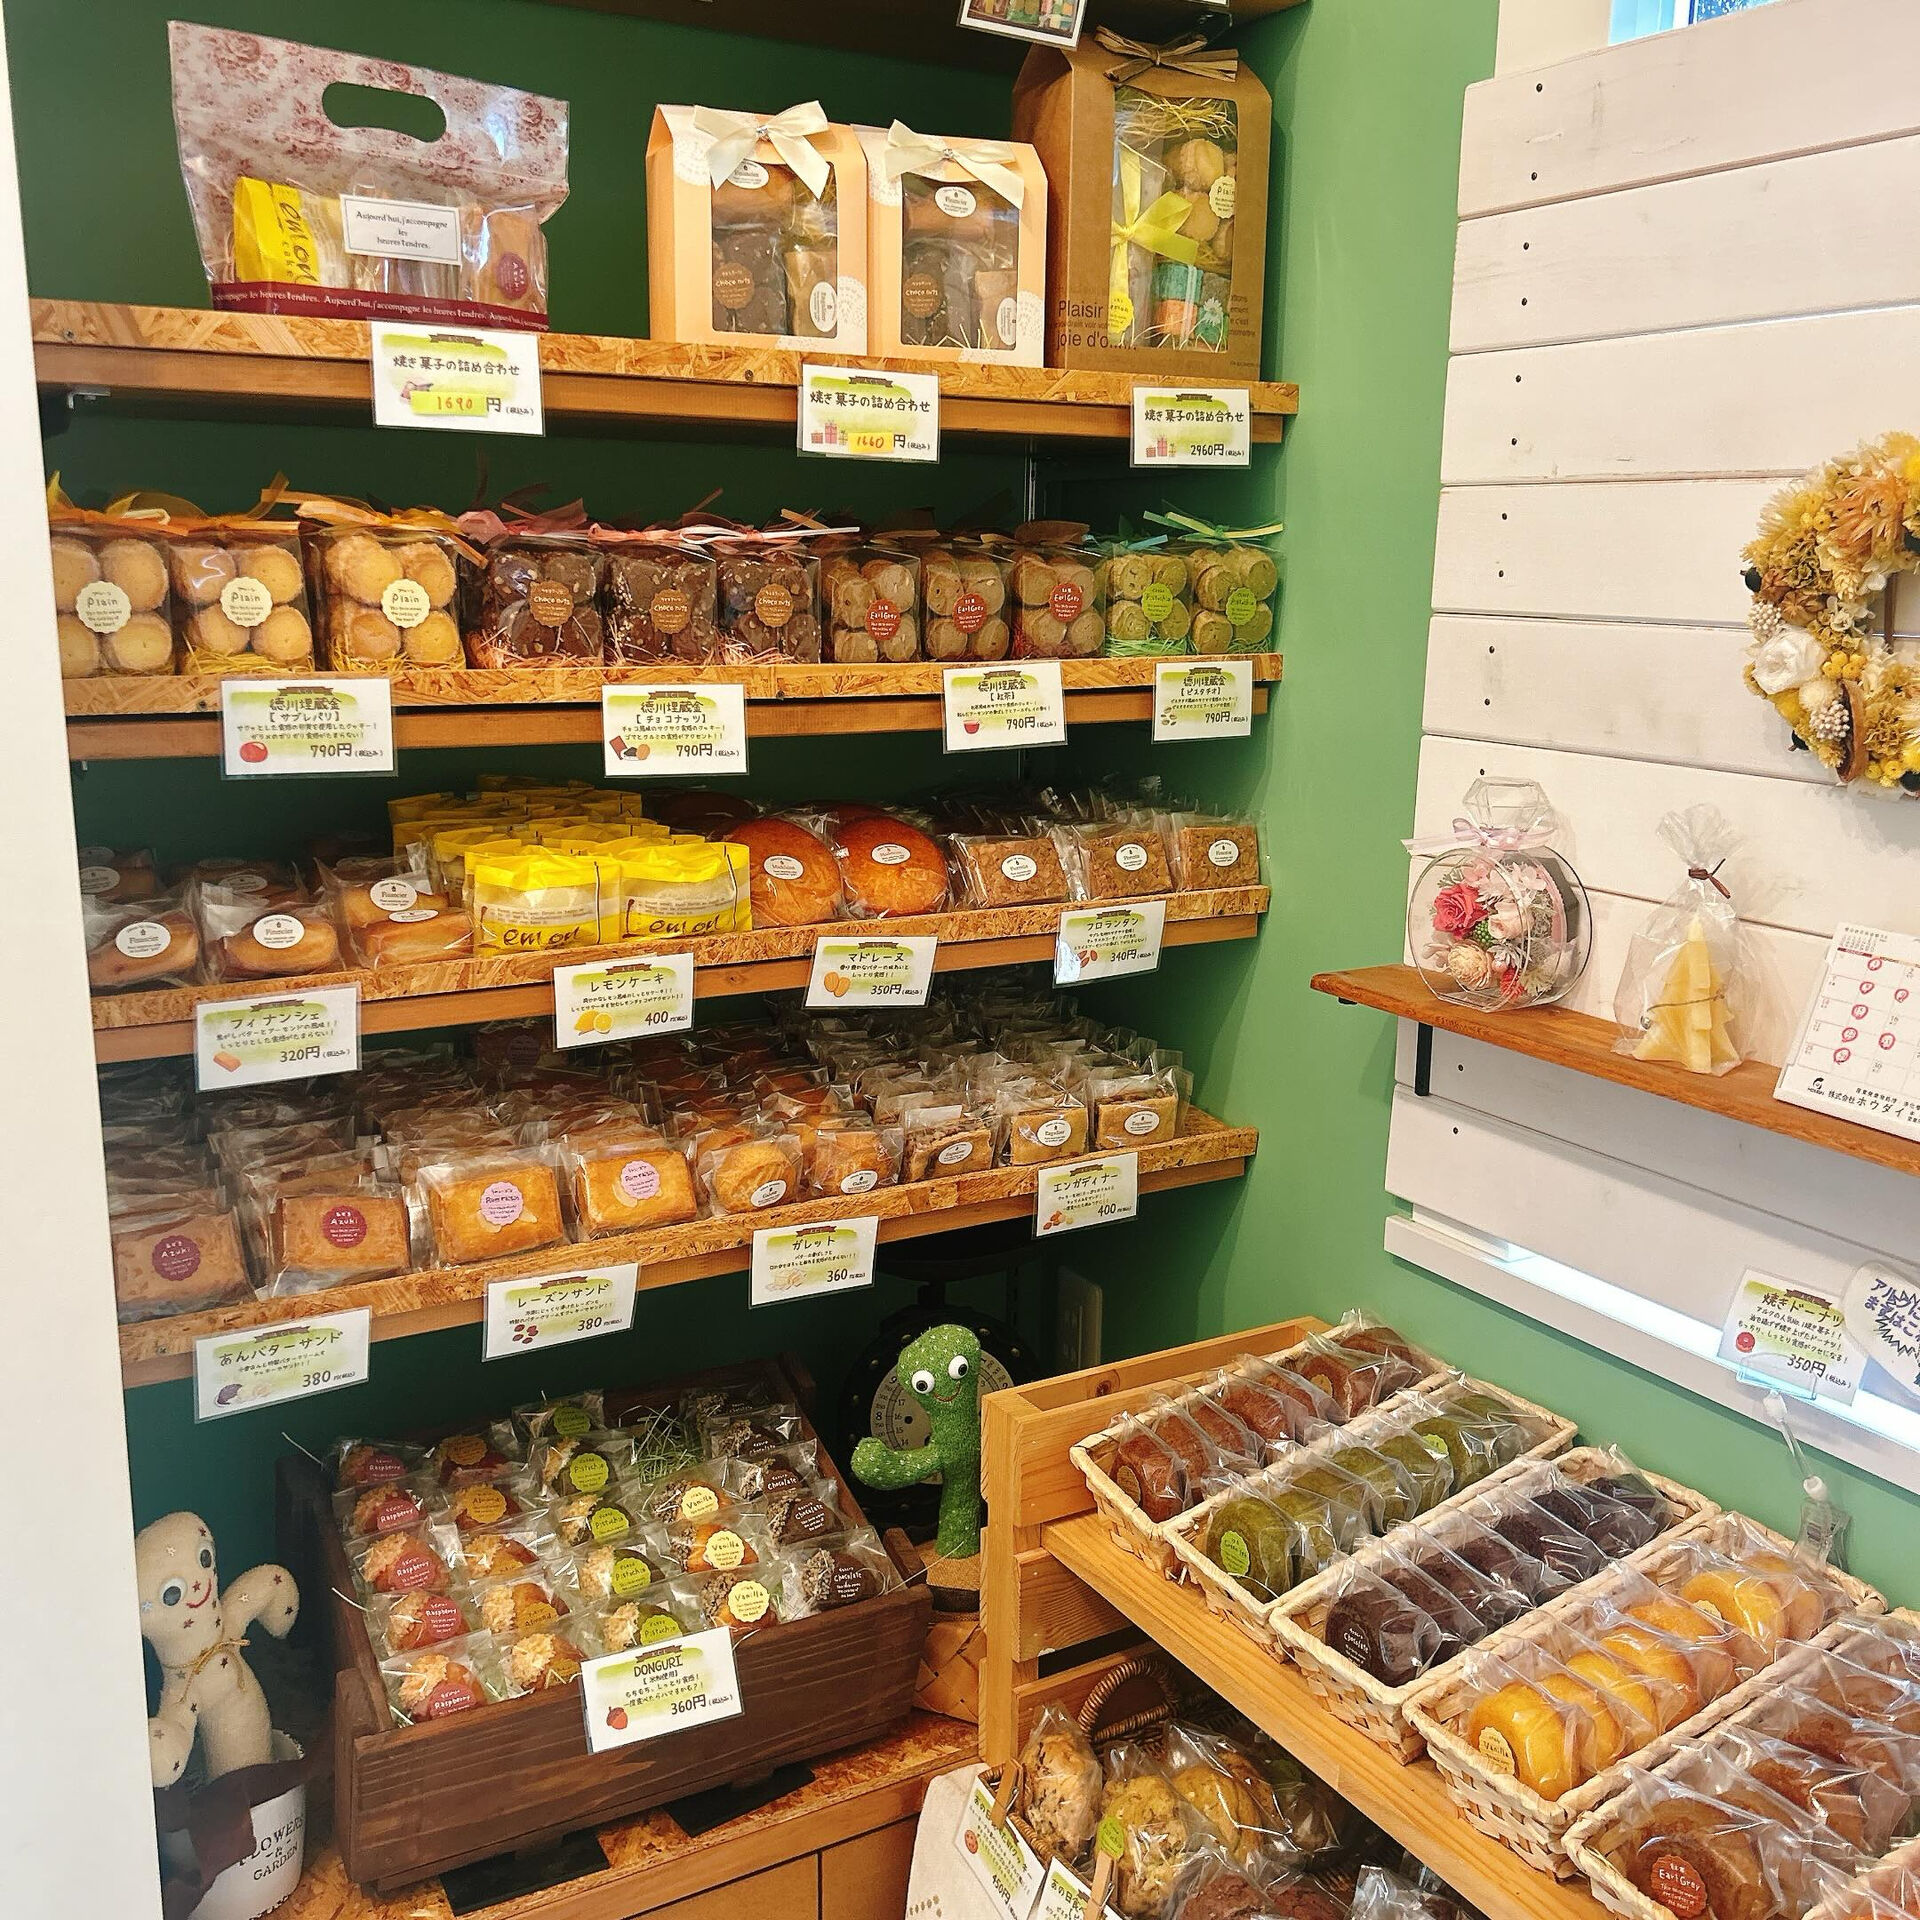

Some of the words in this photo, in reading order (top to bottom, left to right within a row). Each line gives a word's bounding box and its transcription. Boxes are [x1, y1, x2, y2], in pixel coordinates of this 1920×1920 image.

[1058, 300, 1104, 318] Plaisir
[1056, 330, 1081, 351] joie
[393, 355, 519, 376] 焼き菓子の詰め合わせ
[810, 391, 930, 412] 焼き菓子の詰め合わせ
[1144, 408, 1244, 424] 焼き菓子の詰め合わせ
[1190, 443, 1224, 457] 2960円
[87, 597, 118, 608] Plain
[231, 591, 261, 602] Plain
[392, 593, 420, 604] Plain
[978, 679, 1028, 692] 徳川埋蔵金
[1183, 675, 1227, 687] 徳川埋蔵金
[269, 697, 341, 711] 徳川埋蔵金
[641, 701, 704, 714] 徳川埋蔵金
[1006, 716, 1036, 730] 790円
[1205, 711, 1231, 724] 790円
[310, 742, 352, 757] 790円
[676, 743, 713, 757] 790円
[1087, 917, 1139, 932] フロランタン
[848, 951, 905, 962] マドレーヌ
[1110, 949, 1137, 962] 340円
[590, 973, 665, 993] レモンケーキ
[870, 983, 902, 995] 350円
[231, 1011, 320, 1029] フィナンシェ
[644, 1010, 669, 1026] 400
[279, 1045, 321, 1063] 320円
[1053, 1173, 1119, 1193] エンガディナー
[1097, 1203, 1117, 1217] 400
[792, 1235, 836, 1250] ガレット
[161, 1248, 191, 1258] Azuki
[827, 1268, 848, 1282] 360
[518, 1283, 609, 1308] レーズンサンド
[1762, 1292, 1845, 1328] 焼きドーナツ
[577, 1317, 603, 1332] 380
[218, 1330, 344, 1367] あんバターサンド
[1787, 1354, 1827, 1378] 350円
[302, 1370, 332, 1388] 380
[767, 1477, 797, 1490] Chocolate
[686, 1495, 712, 1509] Vanilla
[380, 1508, 413, 1523] Raspberry
[795, 1504, 824, 1519] Chocolate
[712, 1541, 739, 1550] Vanilla
[396, 1561, 429, 1576] Raspberry
[615, 1567, 646, 1581] Pistachio
[834, 1572, 862, 1582] Chocolate
[735, 1591, 763, 1601] Vanilla
[425, 1609, 456, 1617] Raspberry
[644, 1626, 676, 1637] Pistachio
[634, 1655, 683, 1677] DONGURI
[434, 1695, 470, 1709] Raspberry
[671, 1694, 706, 1715] 360円
[253, 1841, 298, 1880] GARDEN
